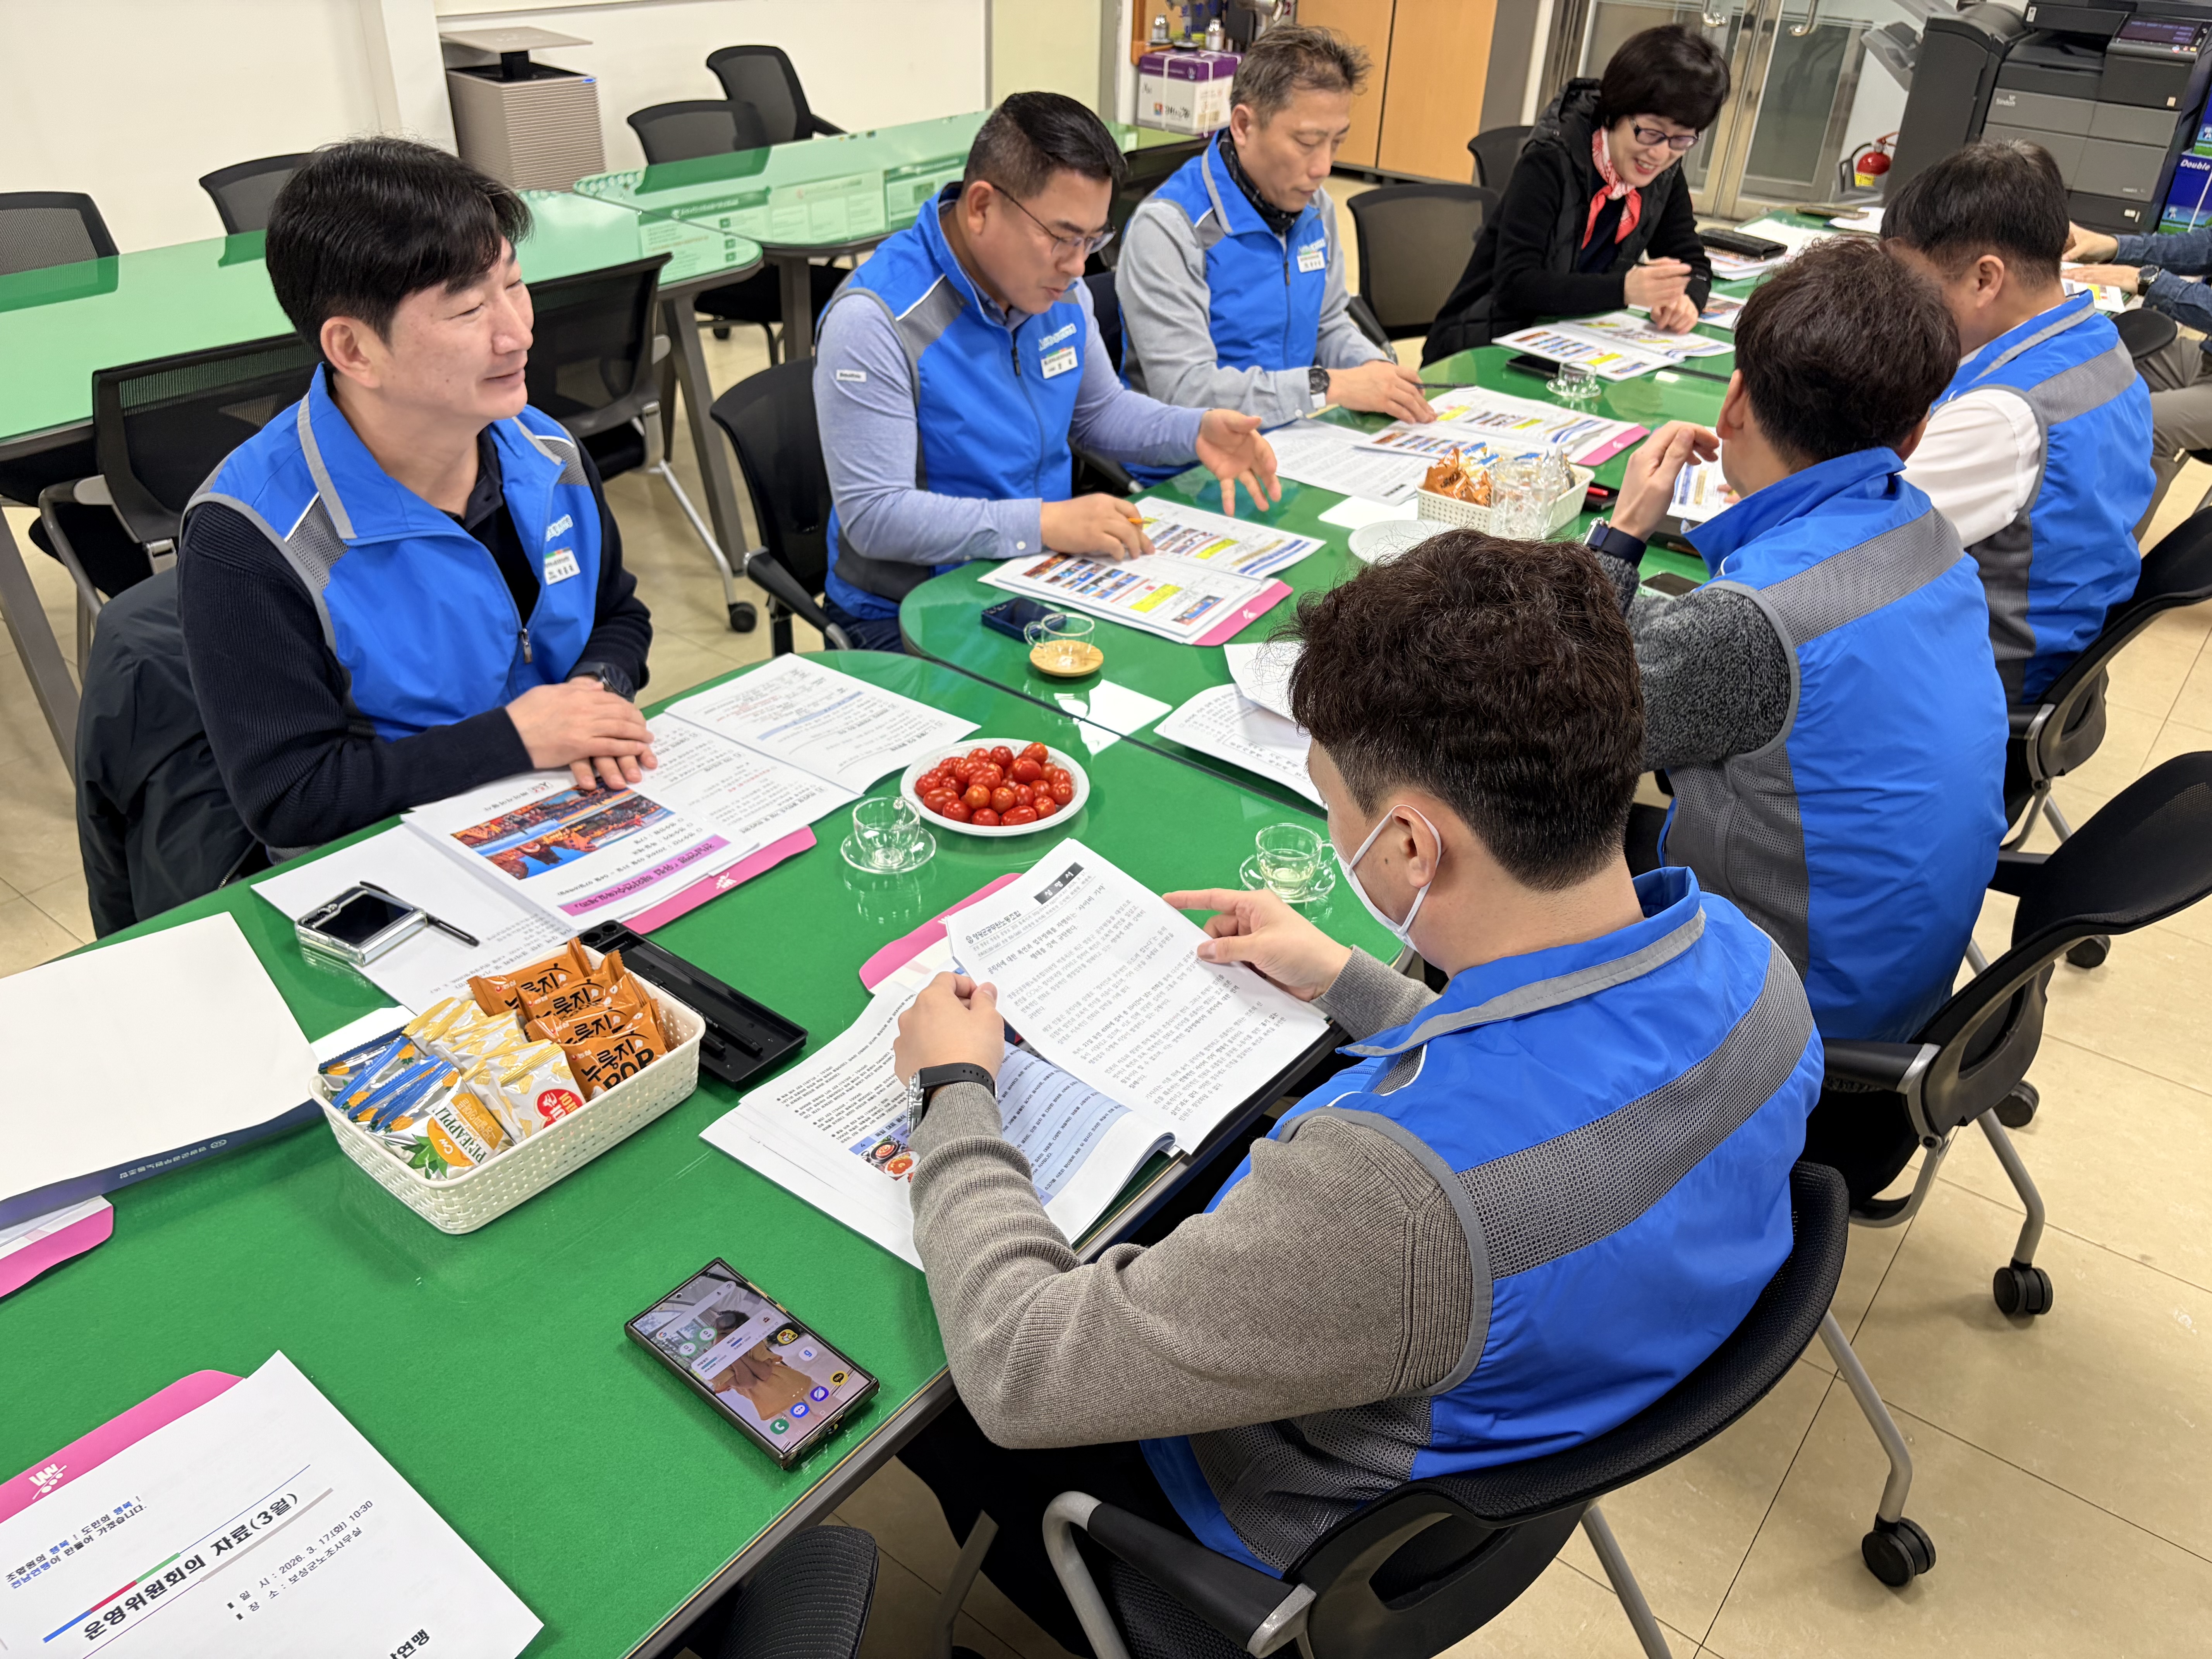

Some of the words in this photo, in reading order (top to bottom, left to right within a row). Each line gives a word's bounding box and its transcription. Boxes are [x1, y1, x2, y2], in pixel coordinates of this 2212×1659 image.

[2180, 159, 2210, 171] Double
[678, 843, 714, 864] 전남연맹
[972, 910, 1022, 940] 영광군공무원노동조합
[988, 960, 1007, 974] 공직자에
[1006, 953, 1017, 962] 대한
[1017, 943, 1033, 954] 폭언과
[1032, 927, 1057, 945] 업무방해를
[1056, 913, 1077, 927] 자행하는
[1030, 948, 1046, 959] 행태를
[1046, 939, 1058, 948] 강력
[1057, 925, 1078, 940] 규탄한다.
[536, 987, 591, 1019] 룽지
[1082, 1039, 1093, 1047] 21일
[1101, 1021, 1115, 1032] 49회에
[1113, 1014, 1124, 1022] 걸쳐
[1127, 997, 1144, 1010] 10시간이
[1151, 981, 1164, 991] 전화를
[1162, 973, 1172, 982] 통해
[1171, 962, 1184, 974] 다수의
[1182, 950, 1195, 963] 공무원
[564, 1013, 612, 1044] 룽지
[1120, 1070, 1139, 1084] 활동이라
[1149, 1051, 1164, 1061] 없으며,
[1171, 1032, 1185, 1043] 명백한
[1184, 1014, 1207, 1032] 업무방해이자
[1206, 1001, 1223, 1014] 공직자에
[581, 1039, 635, 1082] 누룽지
[603, 1048, 654, 1089] POP
[1145, 1085, 1163, 1099] 기자라는
[1188, 1051, 1205, 1064] 공직자를
[1204, 1039, 1220, 1051] 협박하고
[1219, 1027, 1235, 1039] 괴롭히는
[1233, 1017, 1246, 1026] 행위는
[1245, 1005, 1259, 1016] 언론의
[1154, 1096, 1164, 1104] 뢰를
[1163, 1083, 1180, 1096] 훼손하는
[1178, 1070, 1195, 1082] 전형적인
[1216, 1043, 1229, 1053] 행태에
[1227, 1030, 1244, 1044] 불과하다.
[1162, 1091, 1183, 1110] 반복적이고
[1182, 1078, 1199, 1091] 악의적인
[1198, 1069, 1211, 1080] 민원과
[1210, 1057, 1226, 1069] 괴롭힘은
[1225, 1047, 1238, 1057] 공무원
[1237, 1034, 1253, 1048] 노동자를
[1198, 1080, 1212, 1089] 어떠한
[1210, 1068, 1226, 1080] 경우에도
[1225, 1059, 1238, 1068] 인격을
[1237, 1047, 1253, 1059] 말살하는
[1251, 1036, 1264, 1046] 폭언과
[1262, 1027, 1275, 1036] 폭력을
[1274, 1015, 1288, 1027] 동반한
[1129, 1075, 1147, 1089] 침해이다.
[542, 1092, 568, 1121] 마손
[896, 1115, 907, 1123] 음식
[1178, 1108, 1193, 1121] 민원은
[1192, 1094, 1209, 1107] 정당화될
[439, 1139, 453, 1154] CW
[1045, 1178, 1056, 1190] 소고기를
[6, 1554, 46, 1582] 조합원의
[49, 1540, 70, 1554] 행복
[81, 1514, 111, 1535] 도민의
[113, 1501, 133, 1515] 행복
[9, 1555, 61, 1589] 전남연맹이
[64, 1535, 94, 1556] 만들어
[96, 1504, 147, 1536] 가겠습니다.
[279, 1555, 305, 1574] 2026.
[349, 1501, 373, 1521] 10:30
[288, 1527, 362, 1584] 보성군노조사무실
[84, 1554, 206, 1640] 운영위원회의
[210, 1494, 297, 1556] 자료(3월)
[390, 1629, 429, 1659] 연맹
